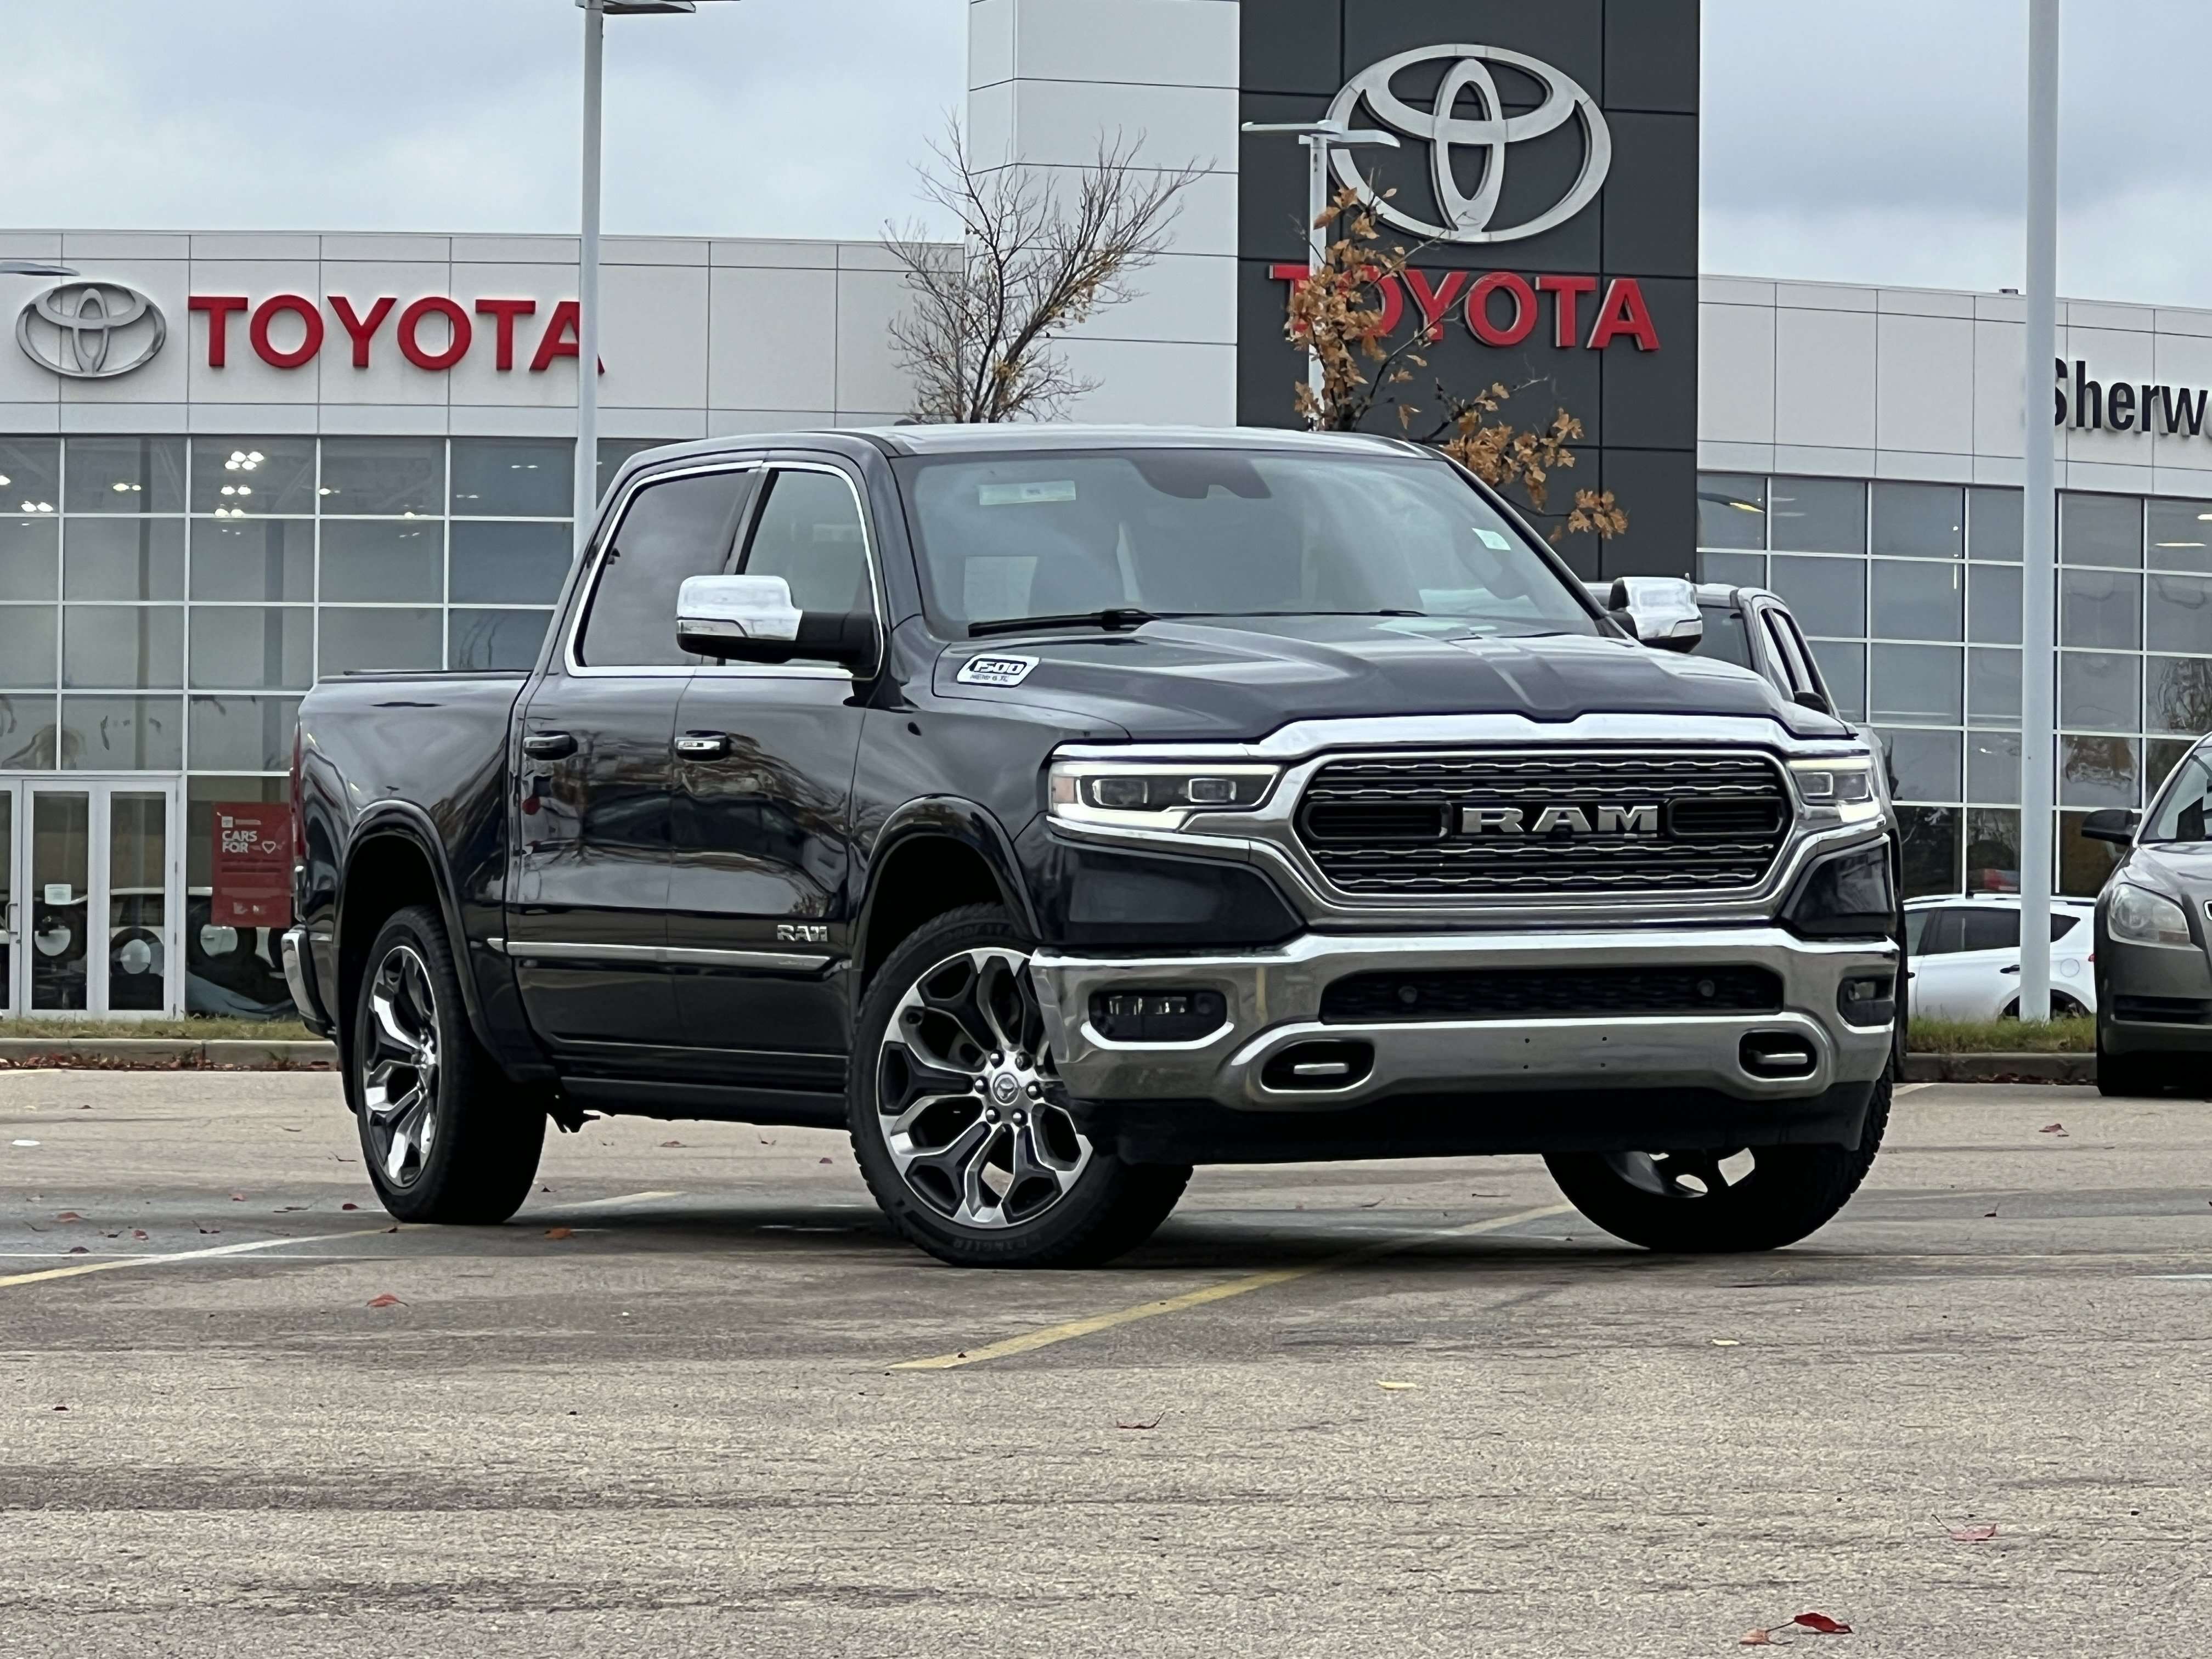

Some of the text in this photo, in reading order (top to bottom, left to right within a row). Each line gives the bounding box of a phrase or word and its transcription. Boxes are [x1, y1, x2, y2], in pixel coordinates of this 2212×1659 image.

[188, 294, 605, 374] TOYOTA
[973, 660, 1025, 674] 1500
[1461, 805, 1658, 833] RAM
[222, 830, 258, 842] CARS
[222, 840, 249, 853] FOR
